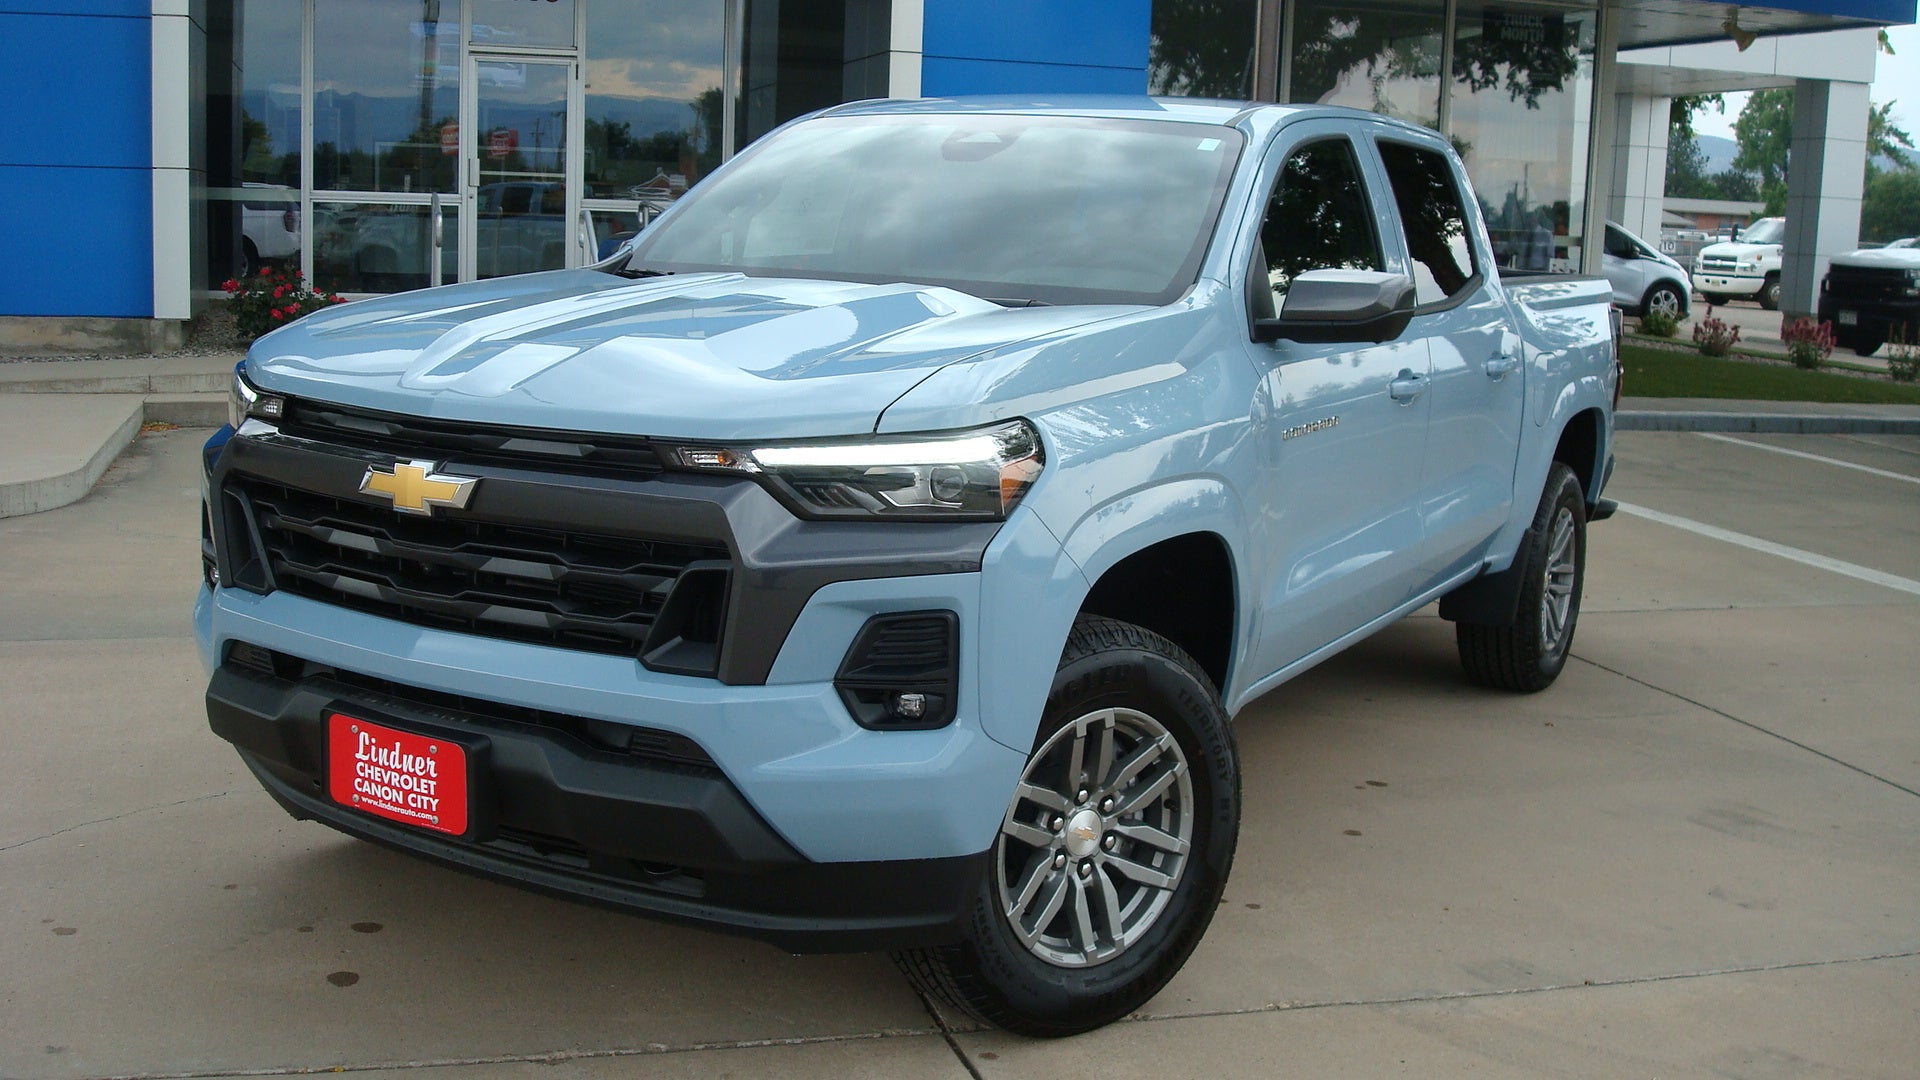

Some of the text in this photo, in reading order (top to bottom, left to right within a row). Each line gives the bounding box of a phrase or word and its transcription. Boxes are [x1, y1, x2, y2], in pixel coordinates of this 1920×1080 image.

[355, 731, 438, 778] Lindner
[354, 778, 439, 812] CANON CITY
[356, 762, 437, 795] CHEVROLET
[361, 796, 433, 820] www.lindnerauto.com
